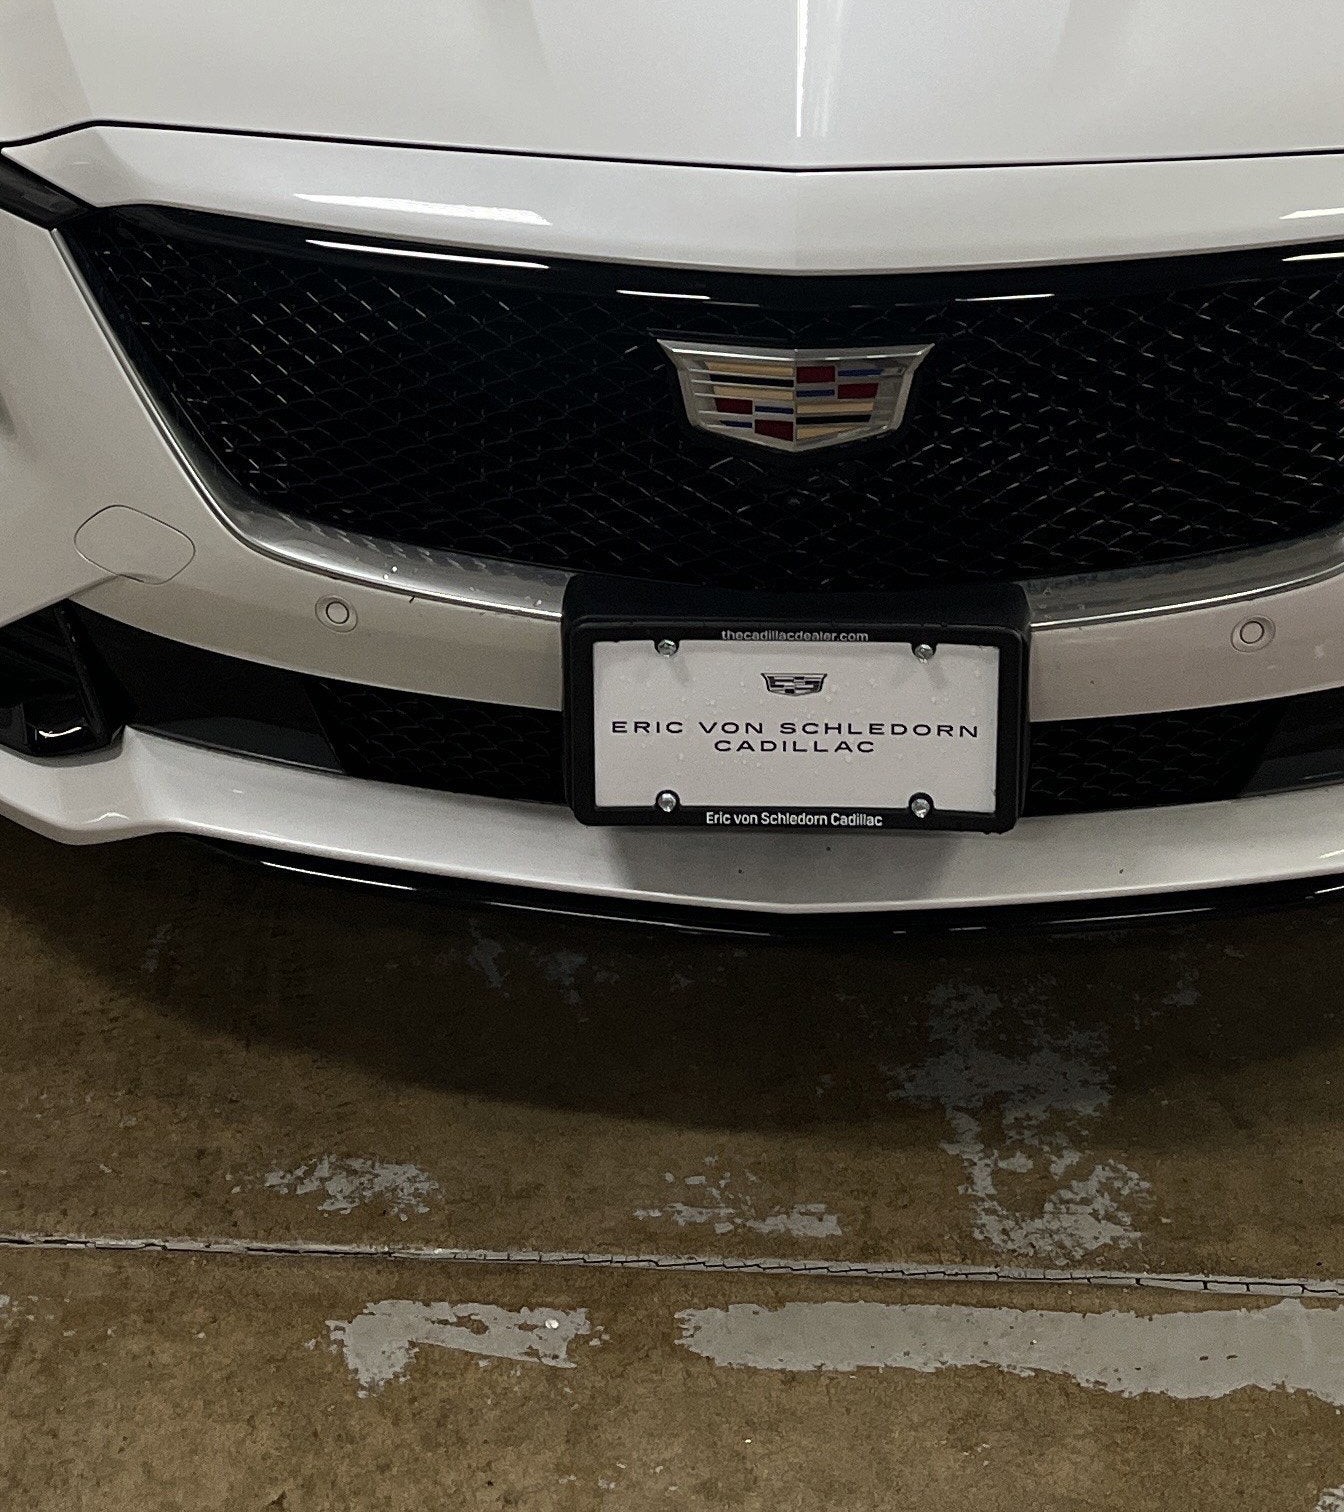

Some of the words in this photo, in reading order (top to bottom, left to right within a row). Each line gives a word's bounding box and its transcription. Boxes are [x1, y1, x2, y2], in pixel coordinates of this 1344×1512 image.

[721, 629, 869, 642] thecadillacdealer.com
[611, 721, 684, 734] ERIC
[698, 721, 763, 734] VON
[779, 722, 978, 738] SCHLEDORN
[714, 740, 875, 752] CADILLAC
[706, 811, 731, 824] Eric
[734, 813, 758, 825] von
[761, 811, 828, 825] Schledorn
[830, 813, 883, 826] Cadillac
